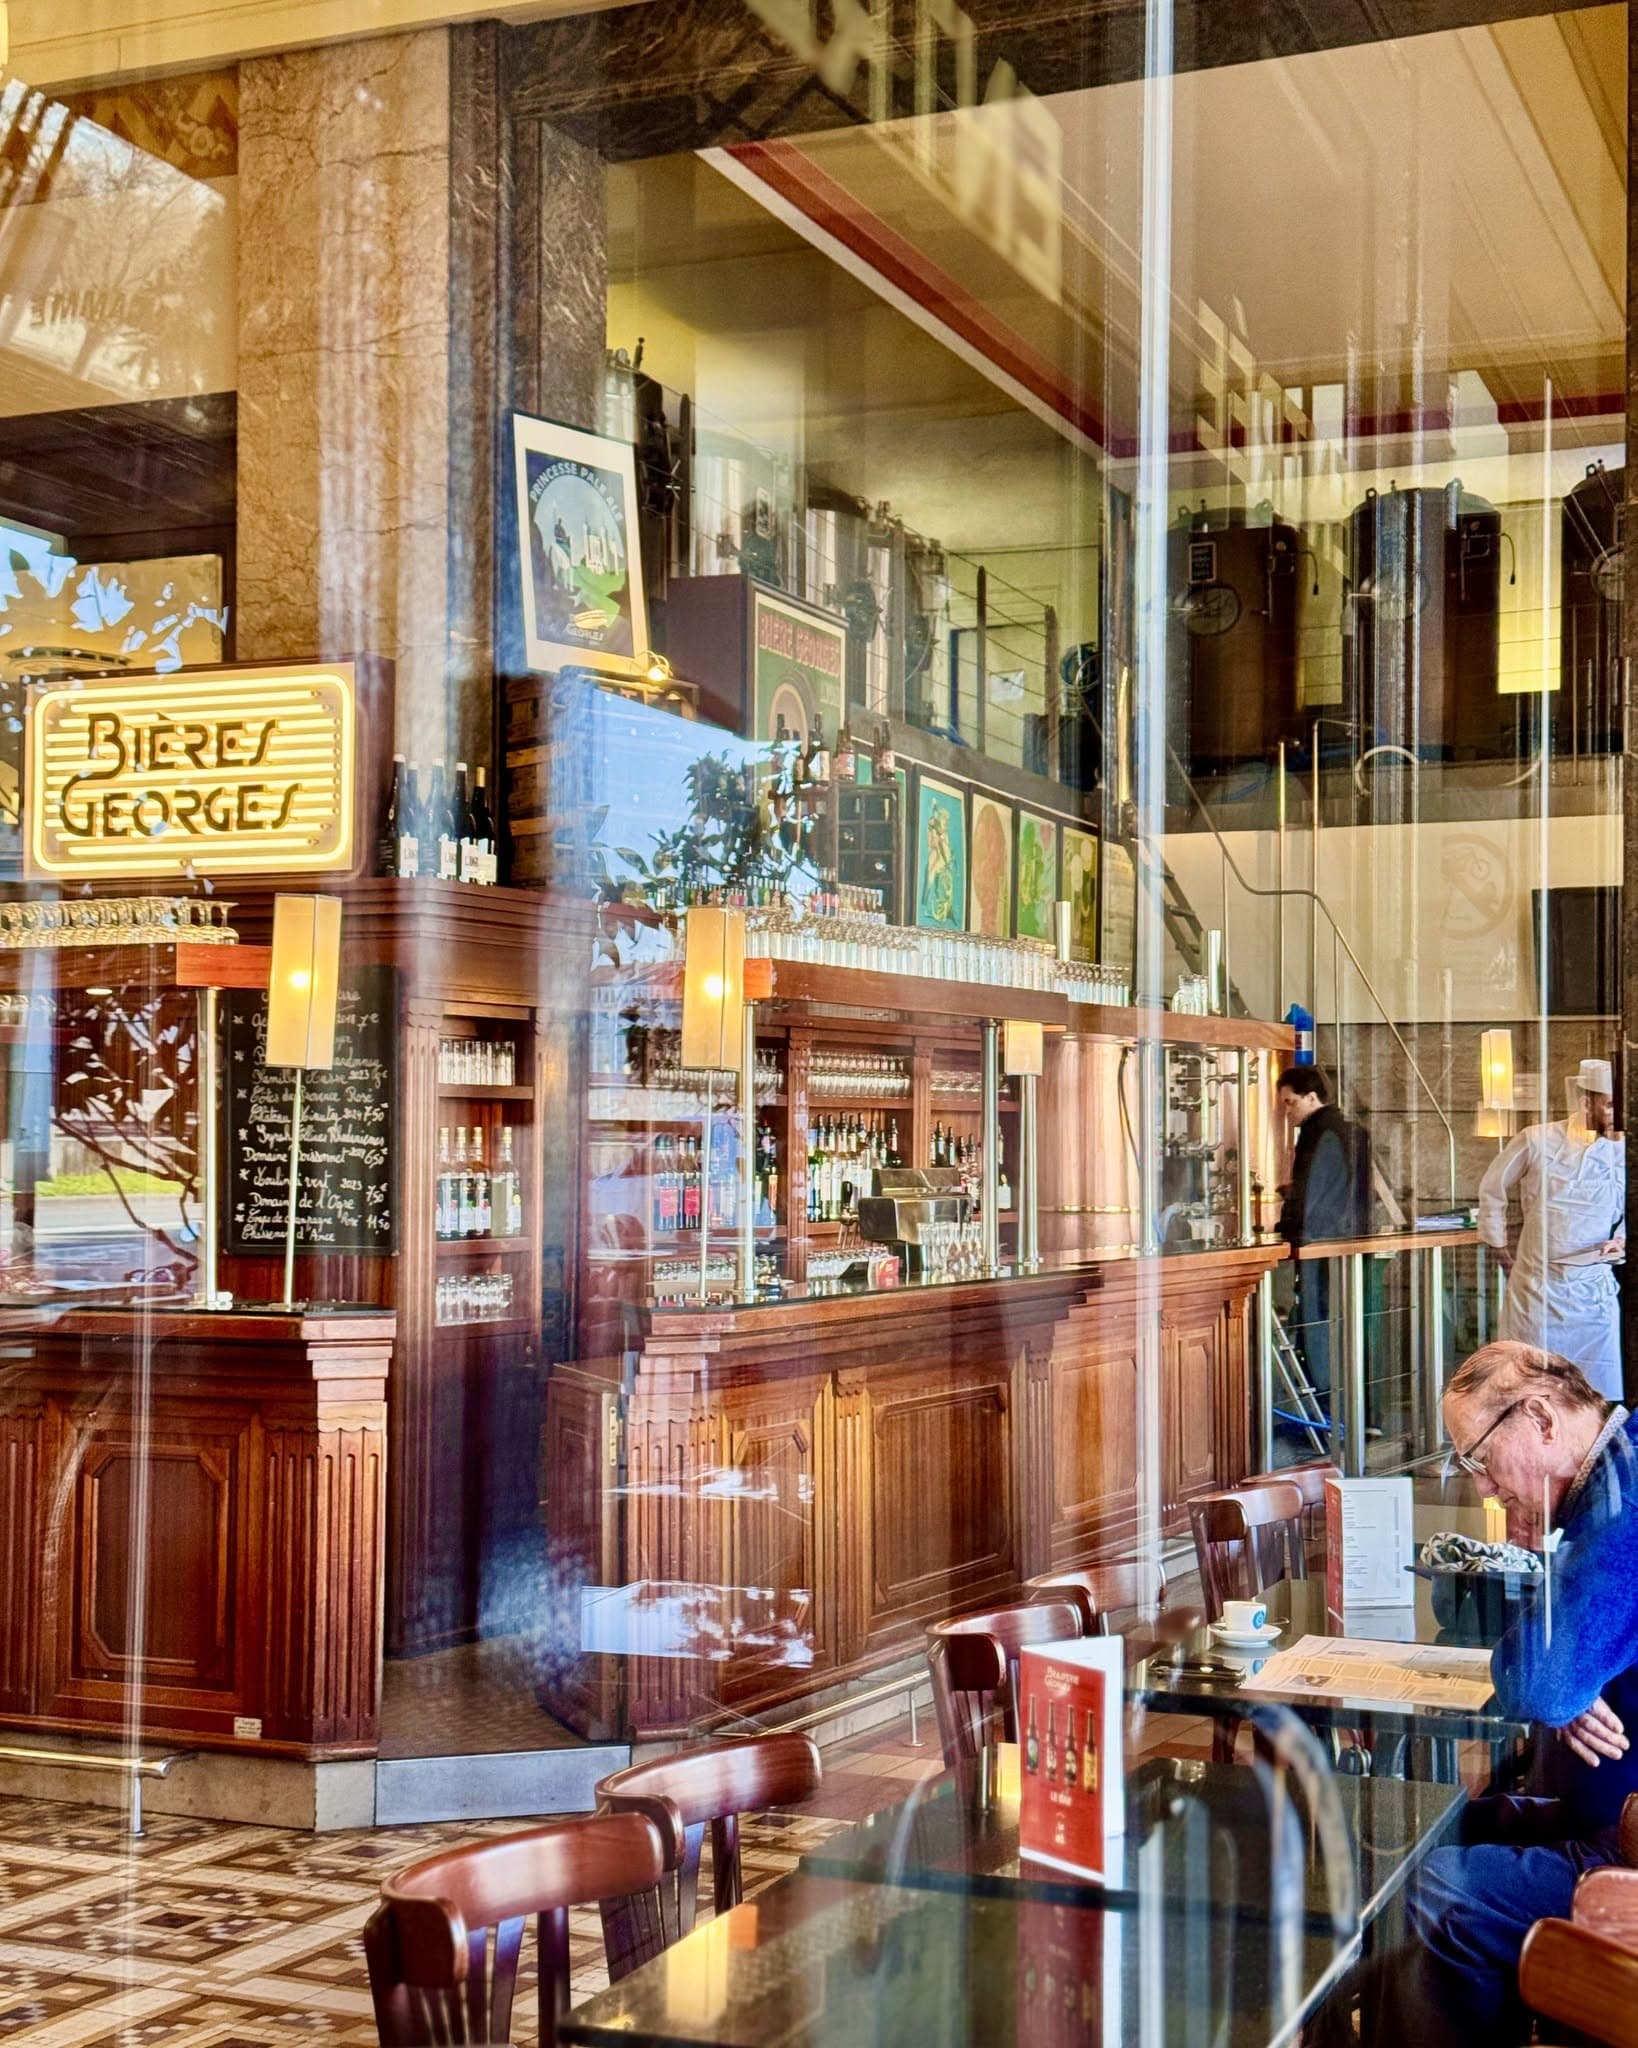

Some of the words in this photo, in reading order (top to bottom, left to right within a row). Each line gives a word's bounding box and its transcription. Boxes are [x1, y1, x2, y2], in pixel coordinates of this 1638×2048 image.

[529, 462, 578, 503] PRINCESSE
[59, 774, 303, 838] GEORGES
[241, 1146, 288, 1162] Domaine
